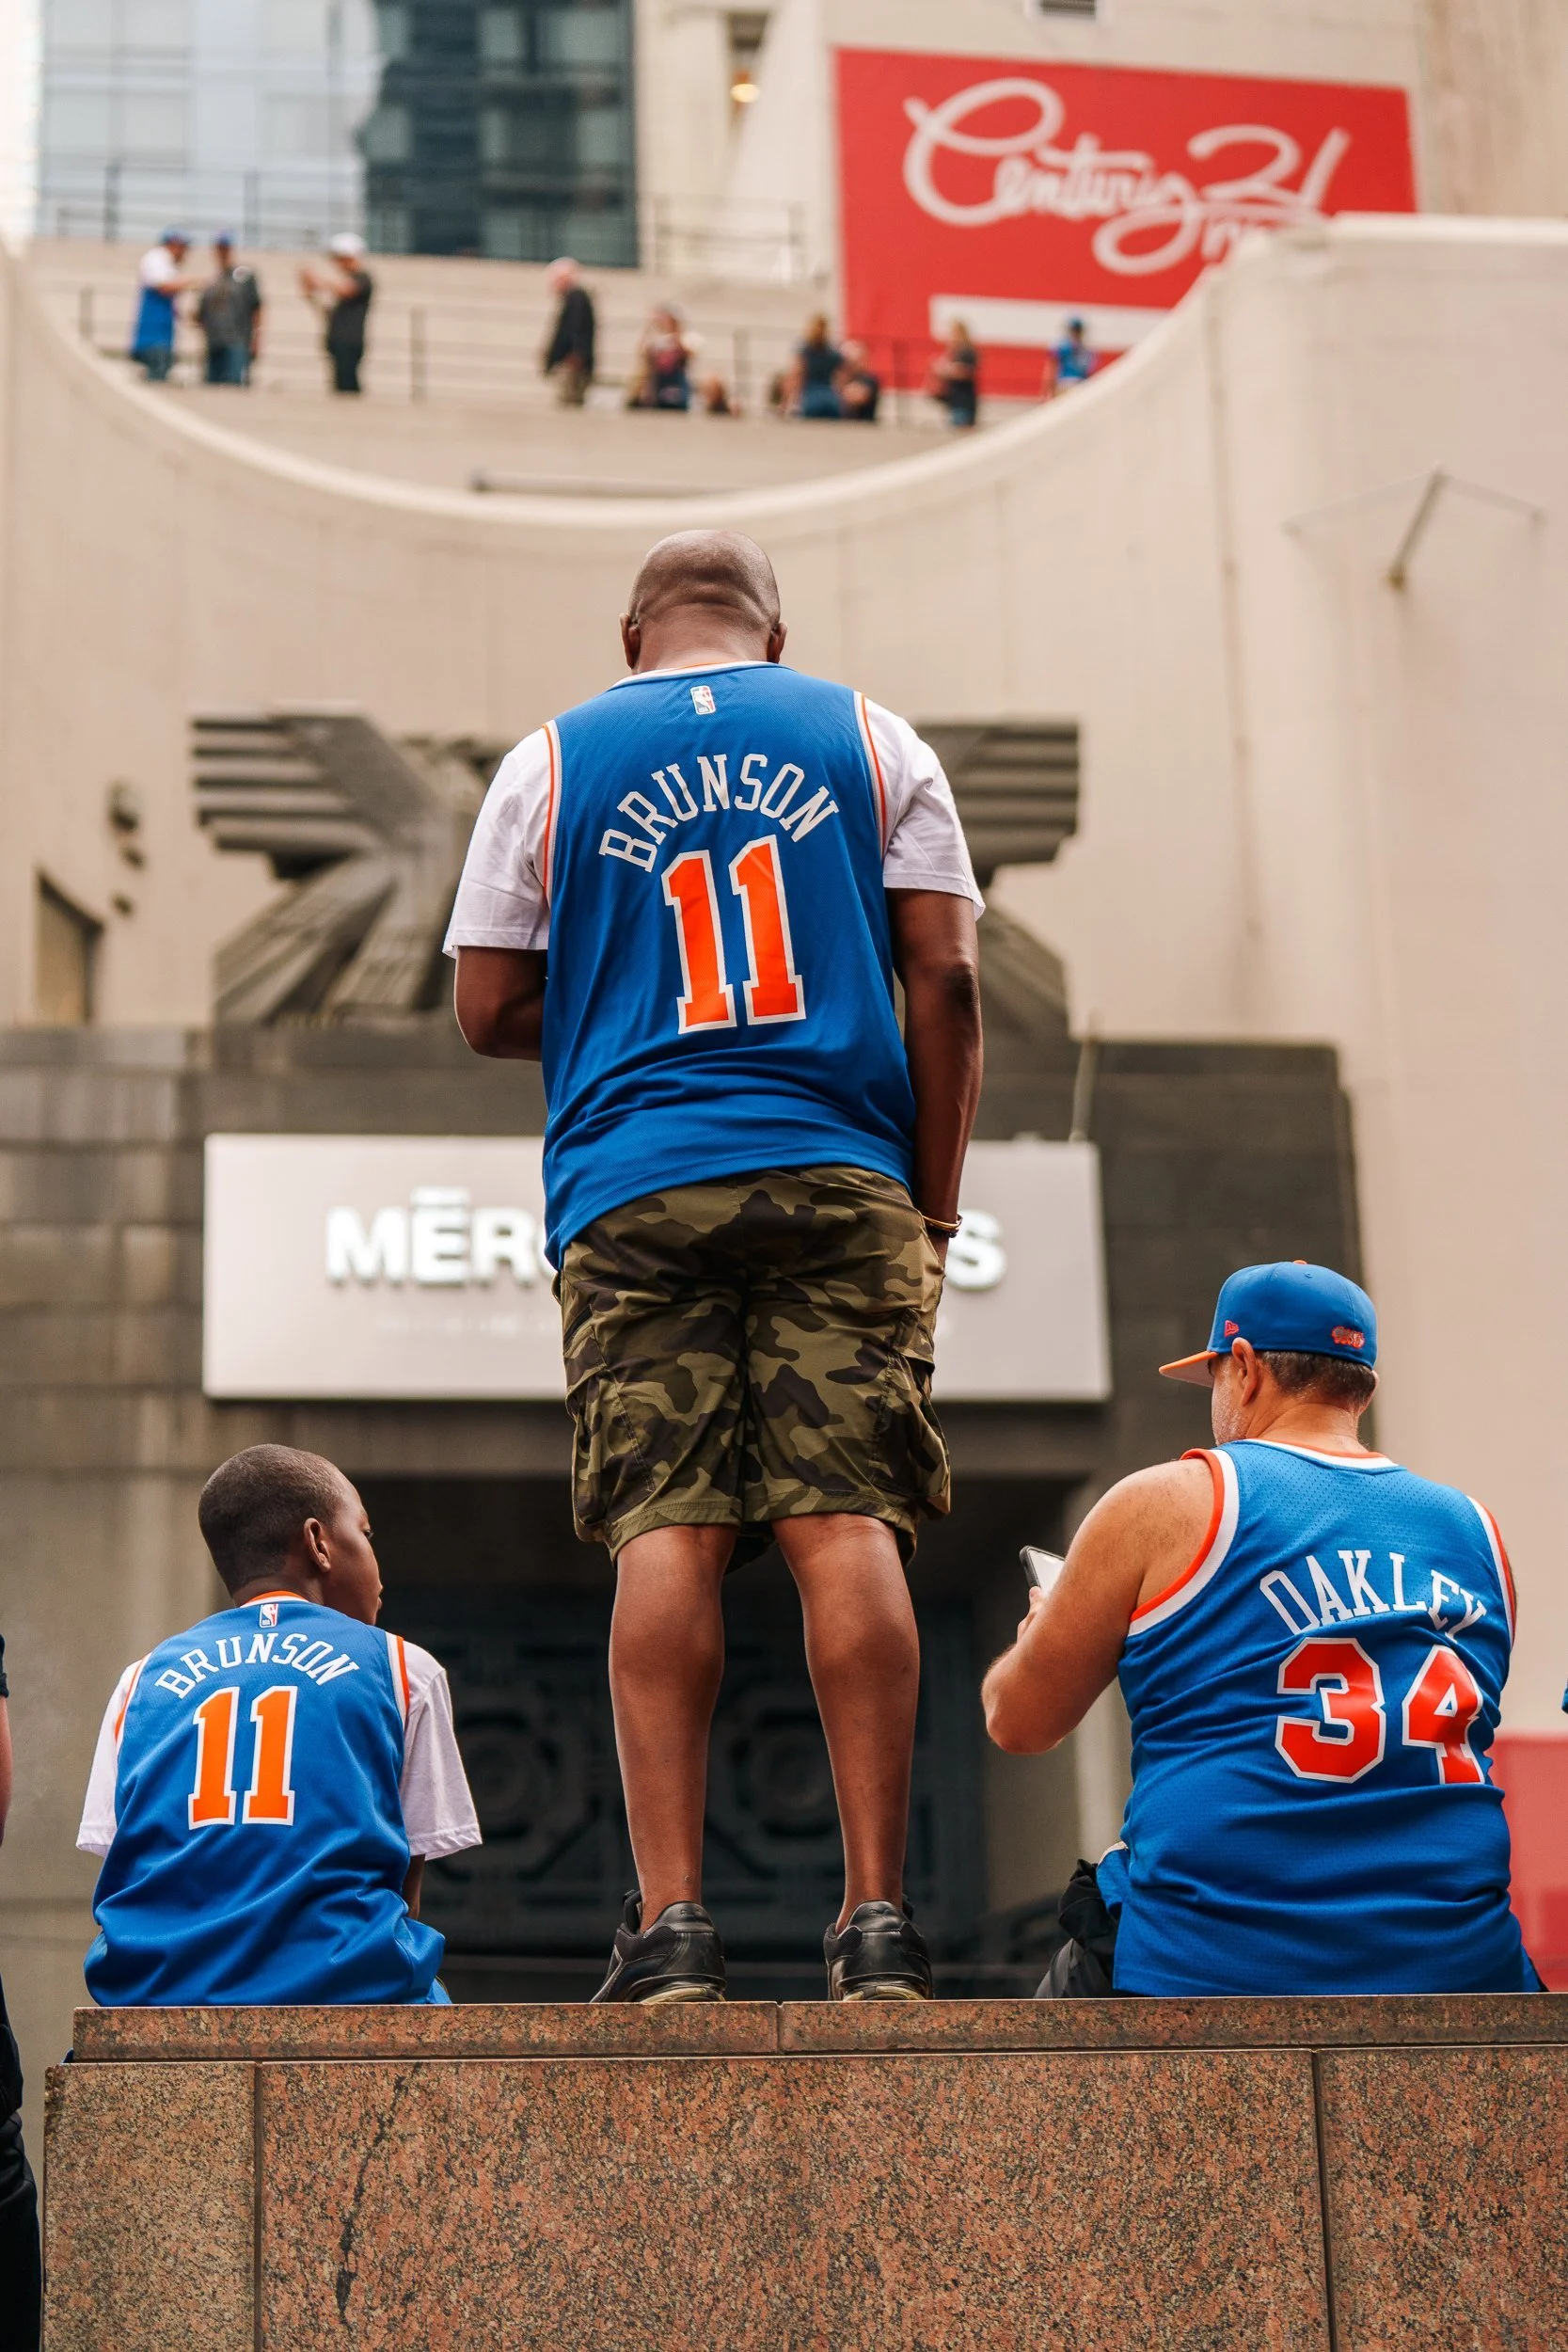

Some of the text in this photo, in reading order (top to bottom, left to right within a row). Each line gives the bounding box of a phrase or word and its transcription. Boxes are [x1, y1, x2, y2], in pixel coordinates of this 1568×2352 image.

[904, 78, 1351, 276] Century 21
[599, 754, 839, 872] BRUNSON
[661, 834, 806, 1034] 11
[325, 1187, 557, 1287] MĒR
[1259, 1549, 1486, 1643] OAKLEY
[154, 1632, 360, 1699] BRUNSON
[1275, 1637, 1485, 1785] 34
[188, 1685, 298, 1830] 11
